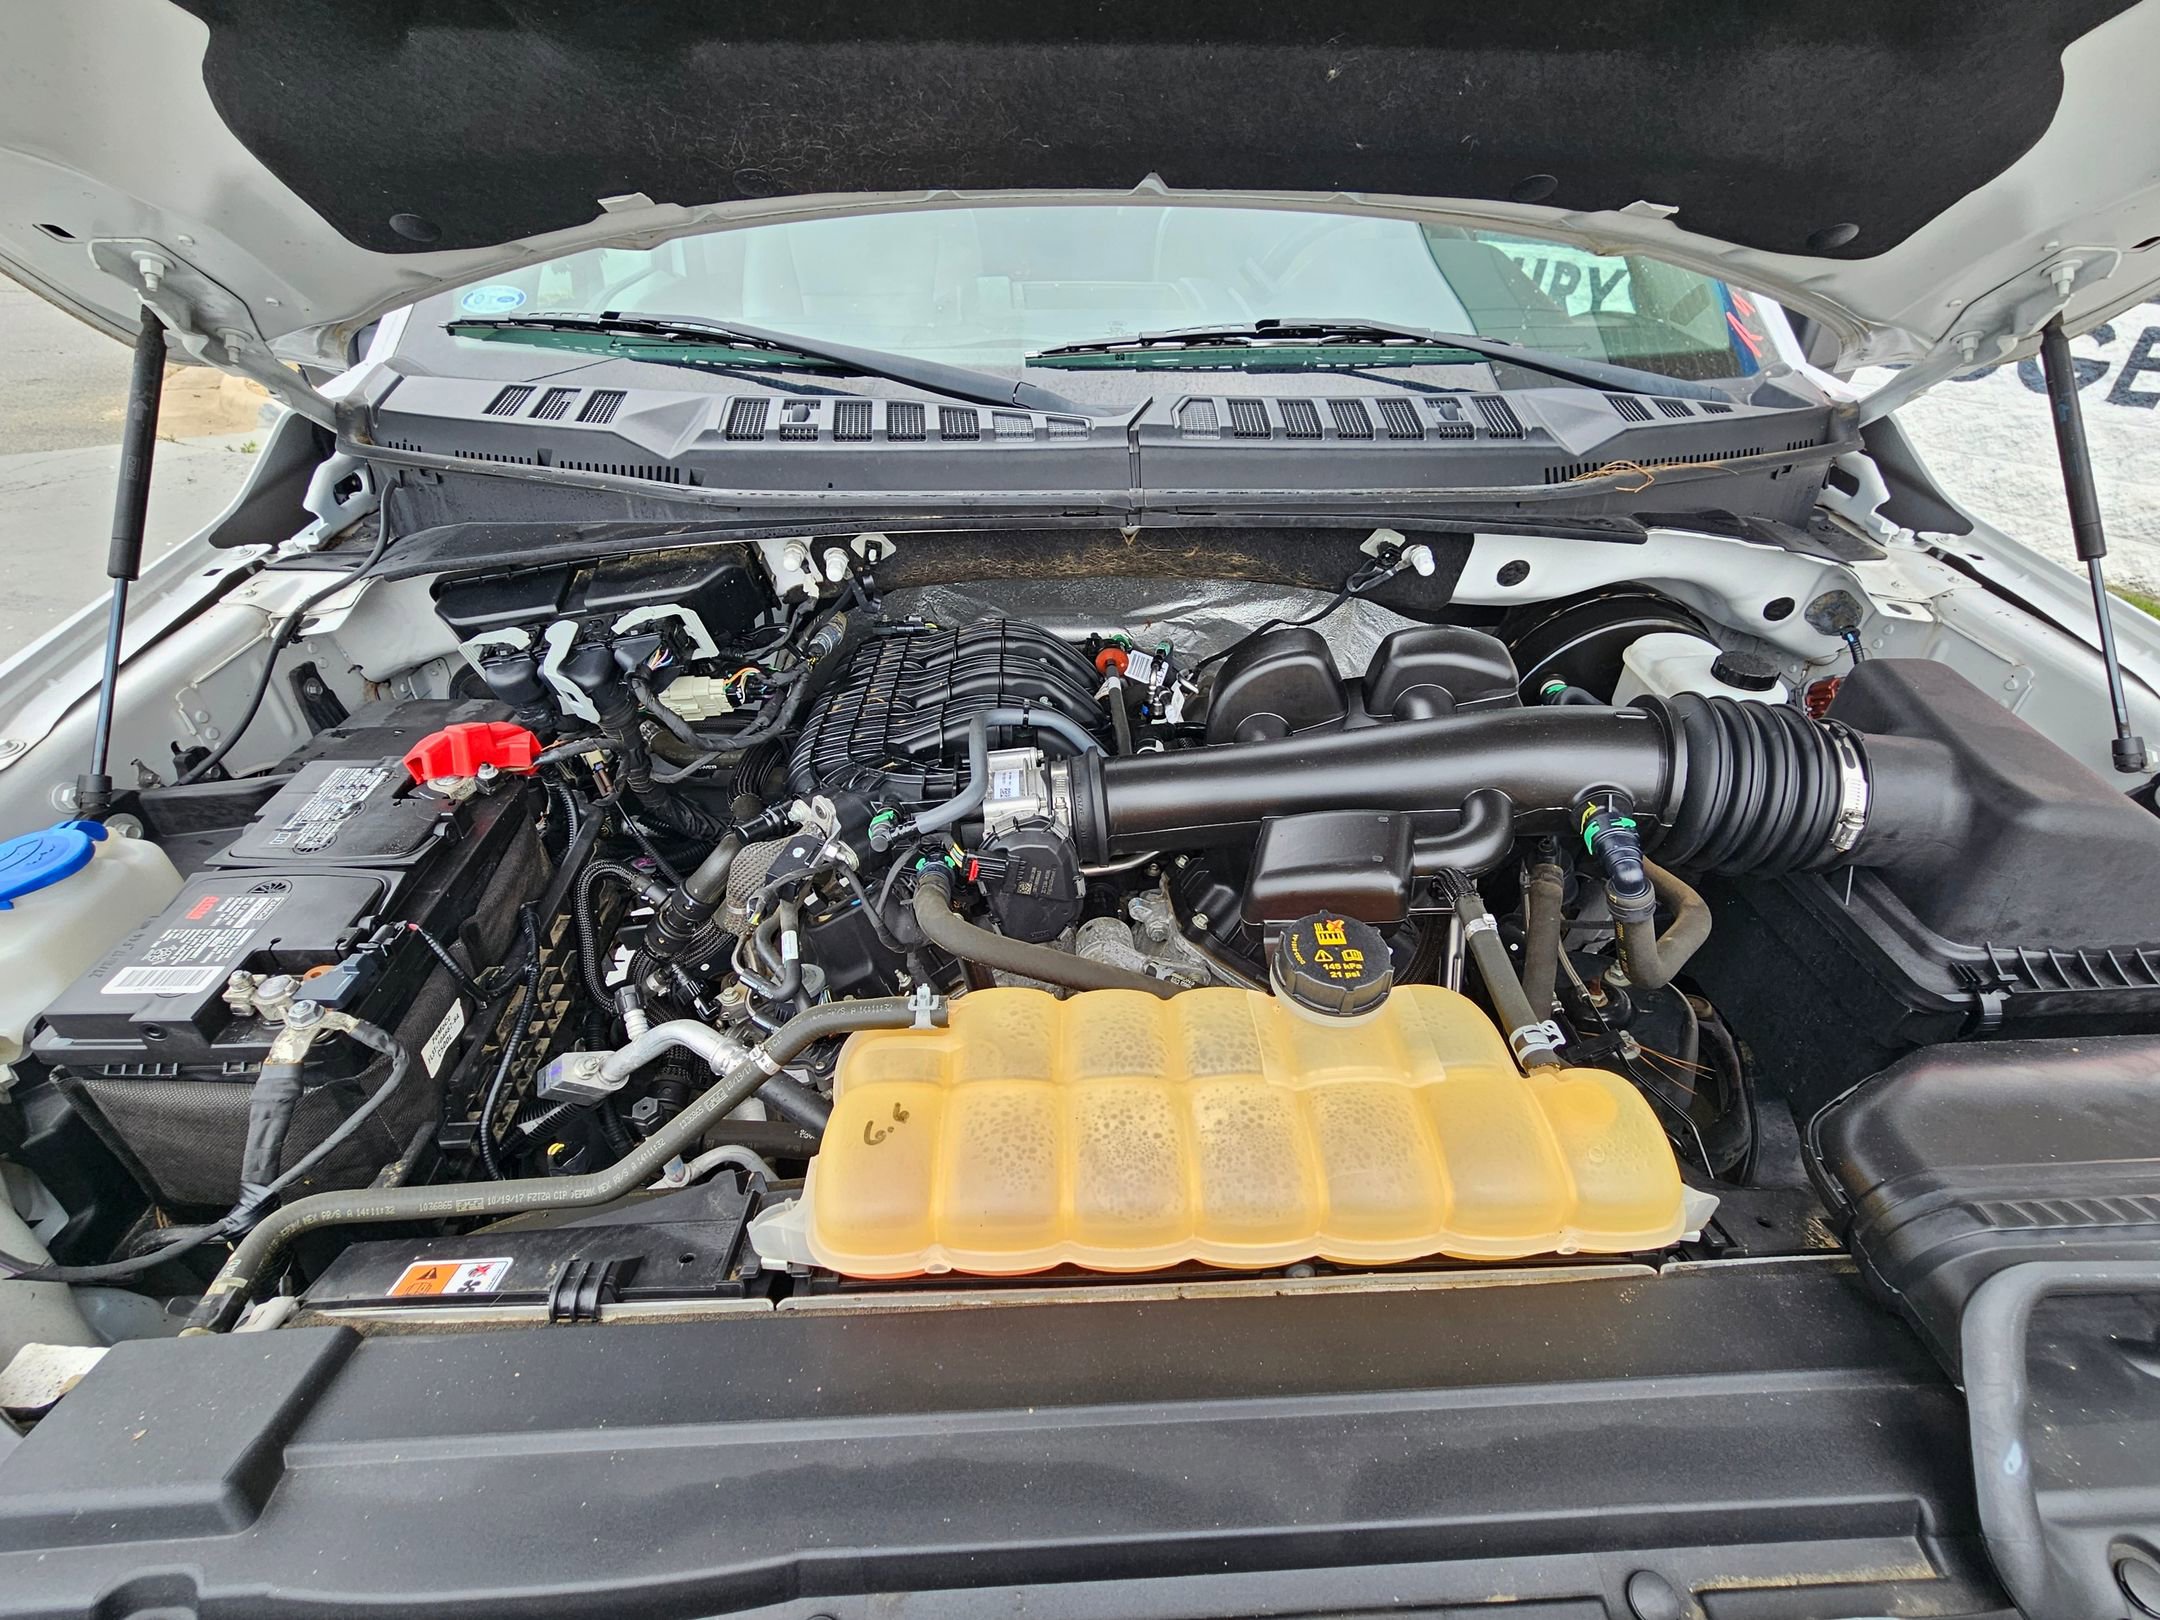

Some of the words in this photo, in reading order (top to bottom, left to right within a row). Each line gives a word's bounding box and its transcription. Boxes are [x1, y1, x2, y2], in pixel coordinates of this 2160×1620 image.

[1323, 962, 1342, 970] 145
[1344, 962, 1363, 970] kPa
[1344, 971, 1361, 979] psi
[487, 1193, 524, 1206] 10/19/17
[356, 1205, 397, 1218] 14:11:32
